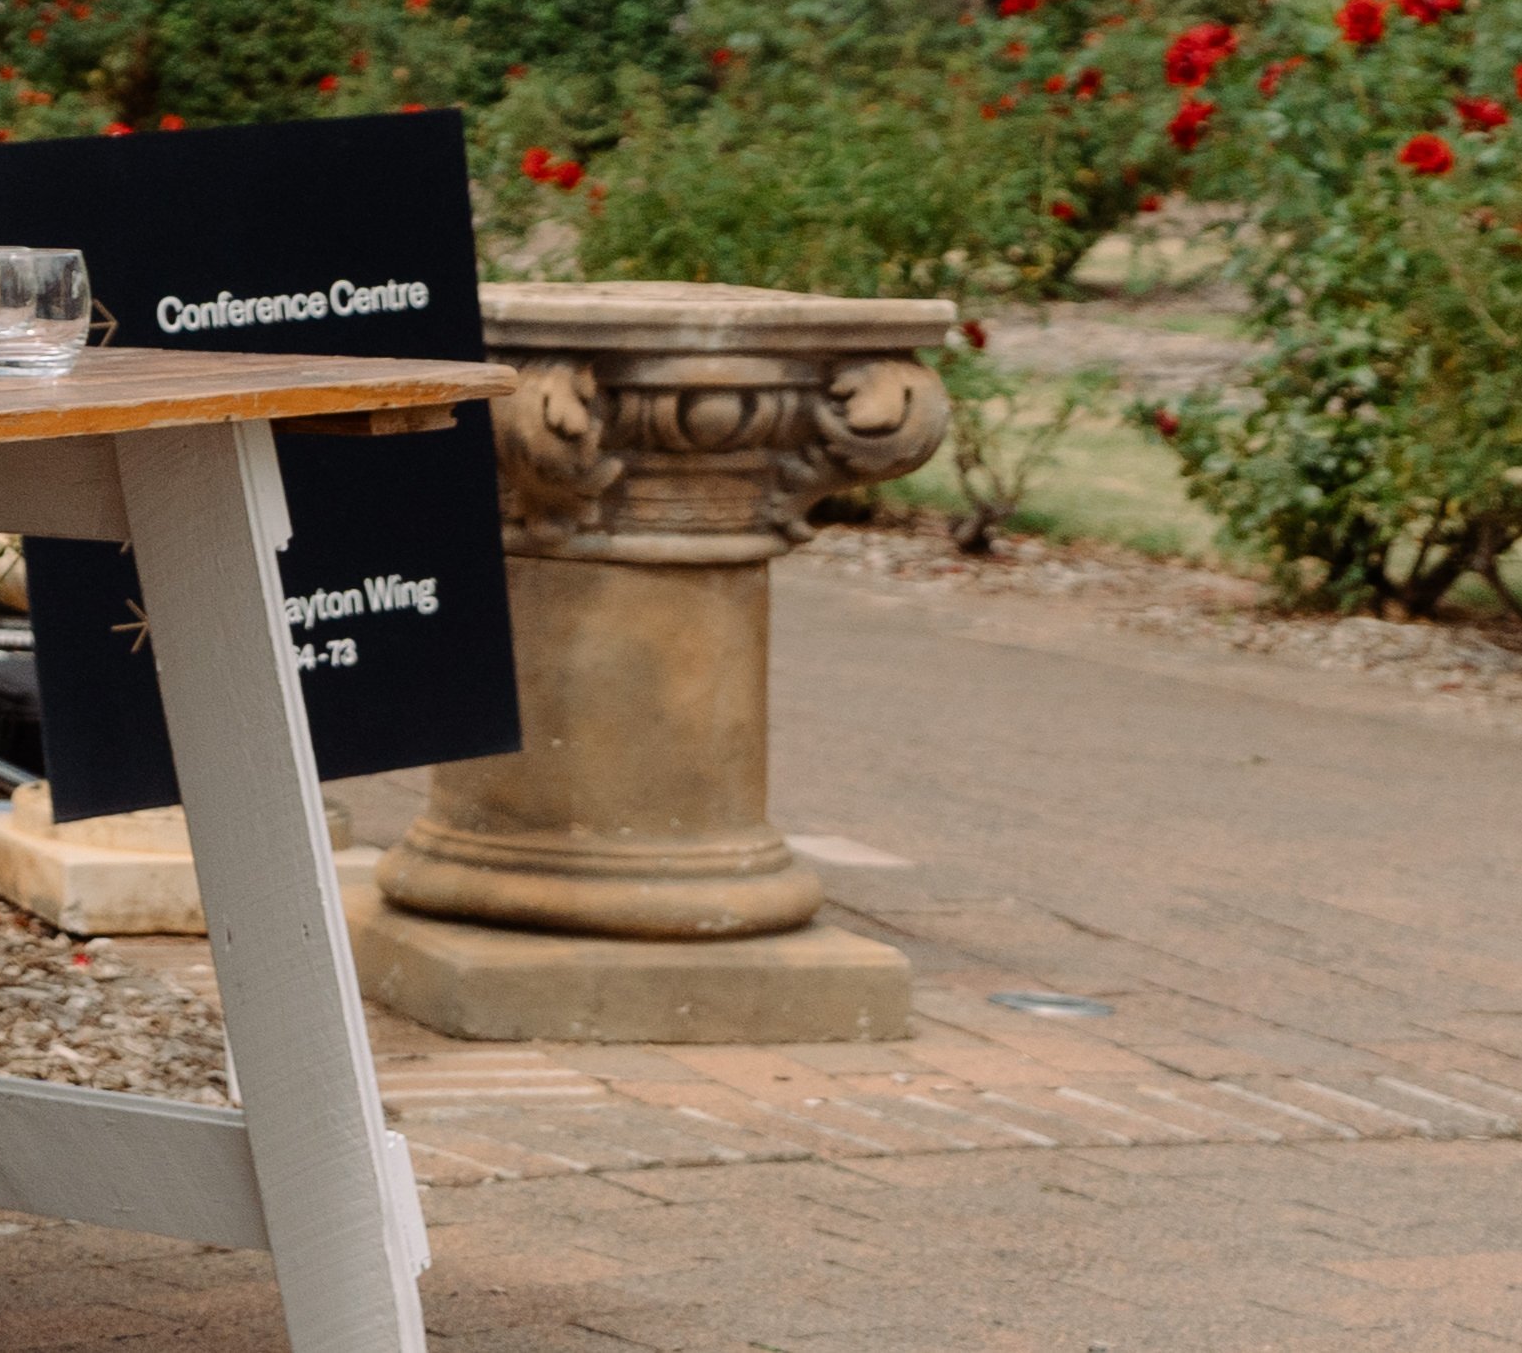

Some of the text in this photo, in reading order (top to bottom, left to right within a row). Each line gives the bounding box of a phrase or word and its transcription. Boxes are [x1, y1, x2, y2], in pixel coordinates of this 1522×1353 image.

[156, 279, 430, 334] Conference Centre
[284, 574, 439, 630] ayton Wing
